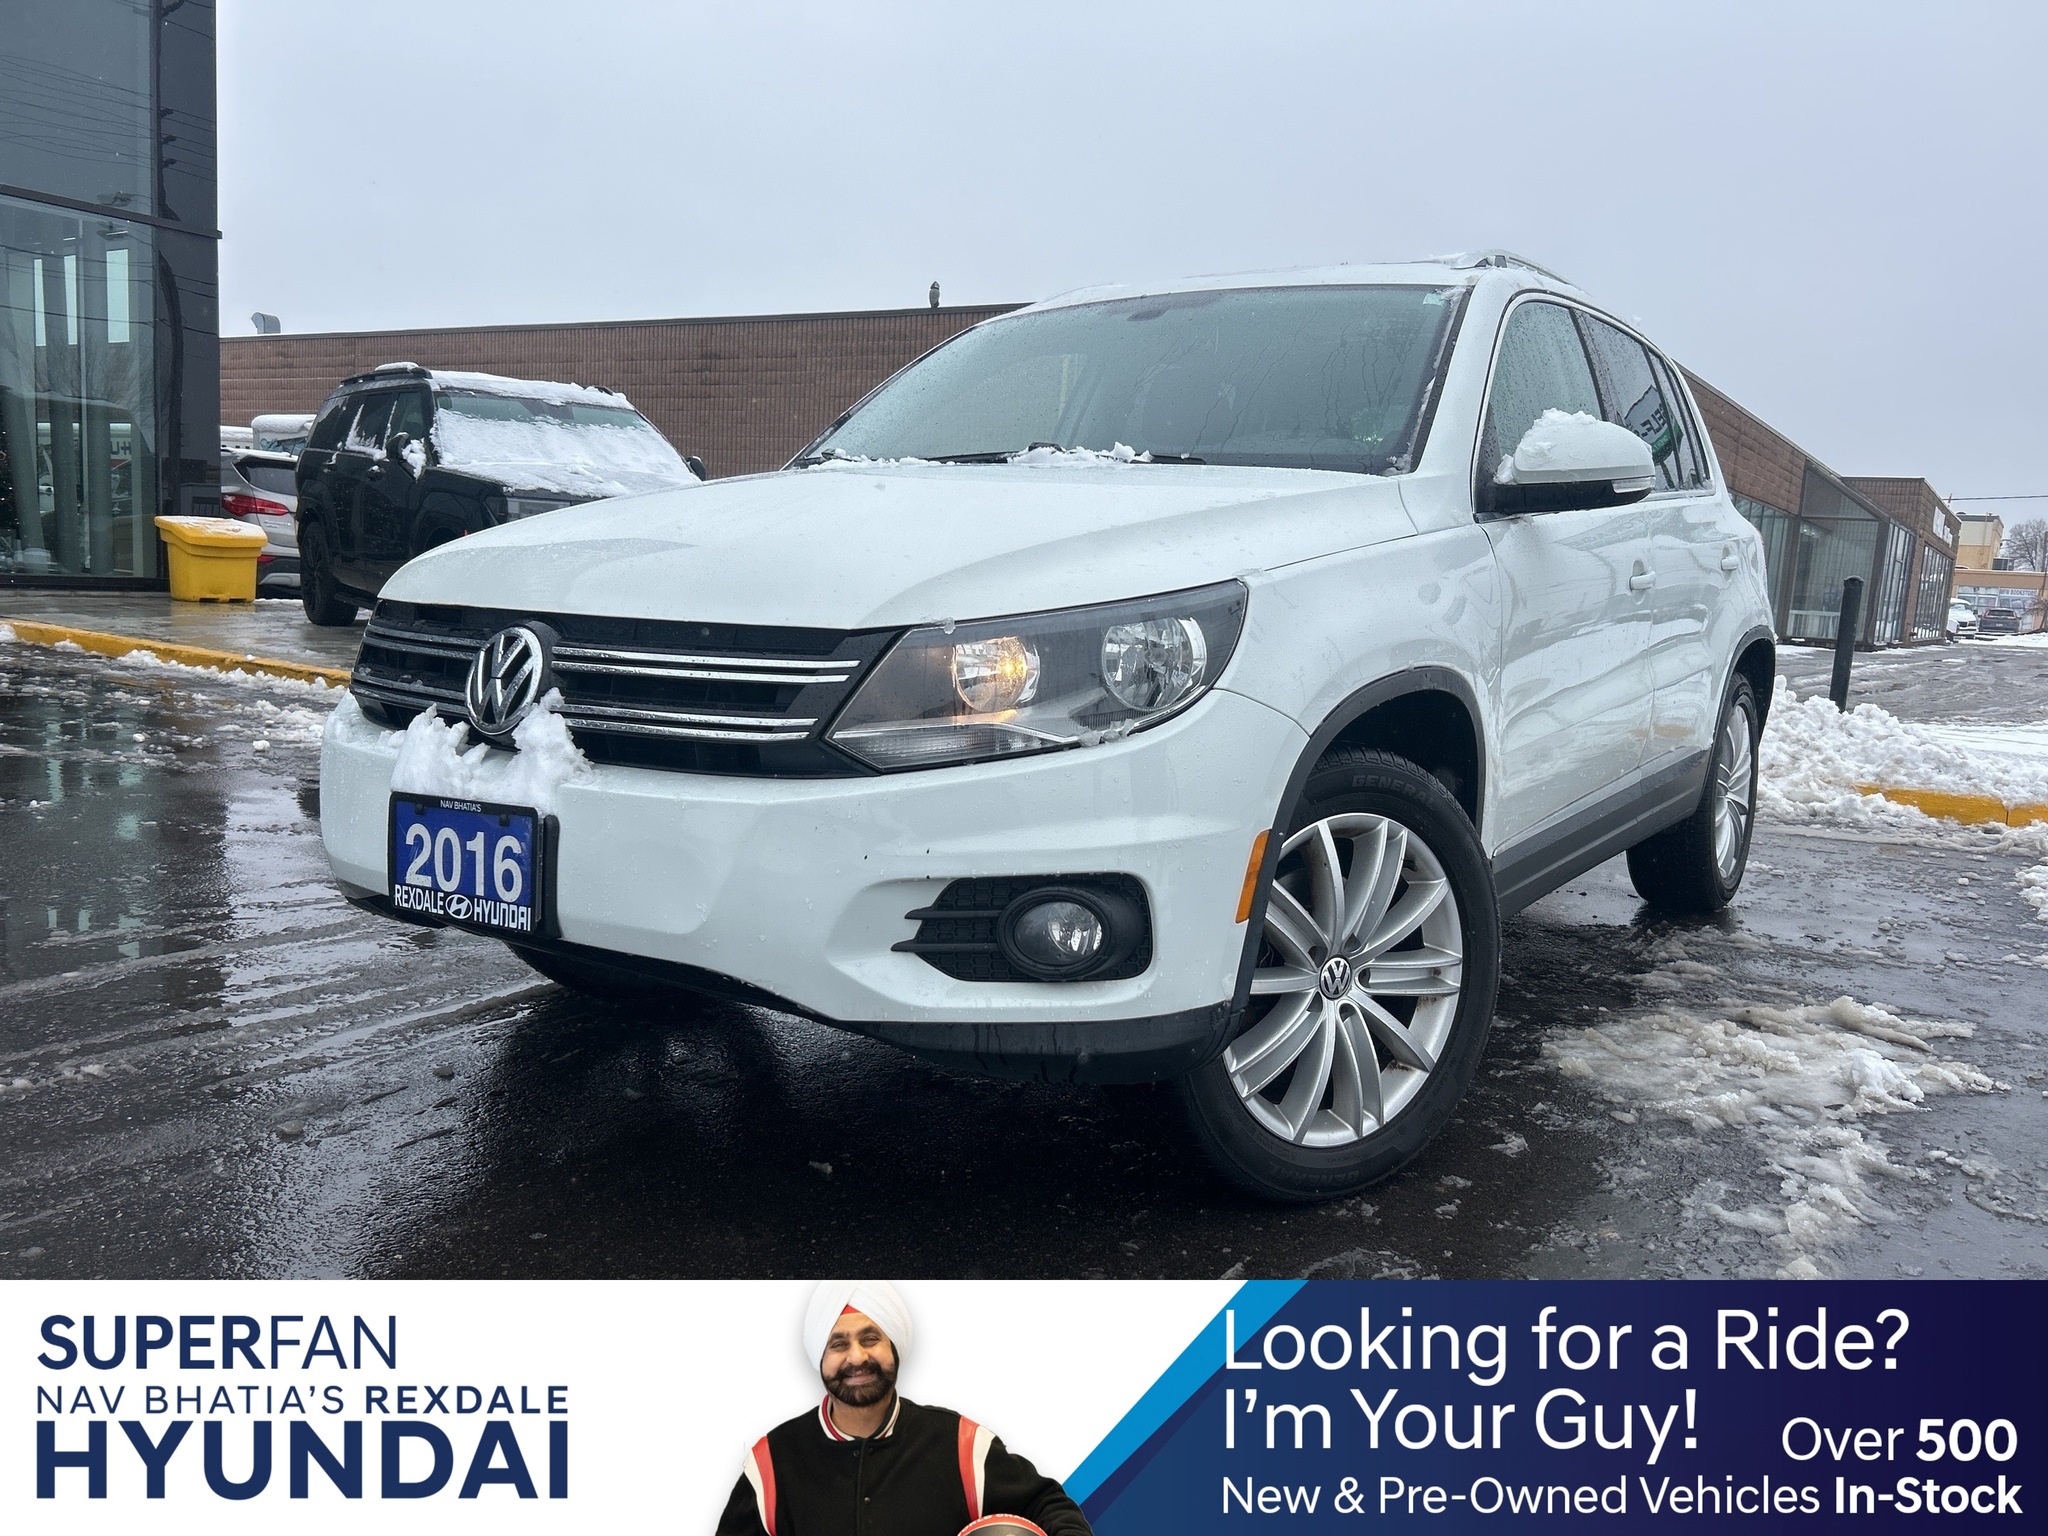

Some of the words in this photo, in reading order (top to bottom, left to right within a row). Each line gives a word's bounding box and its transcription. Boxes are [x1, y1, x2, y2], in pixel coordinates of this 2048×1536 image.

[440, 800, 454, 809] NAV
[454, 801, 482, 812] BHATIA'S
[405, 823, 523, 903] 2016
[394, 884, 444, 915] REXDALE
[473, 898, 531, 931] HYUNDAI
